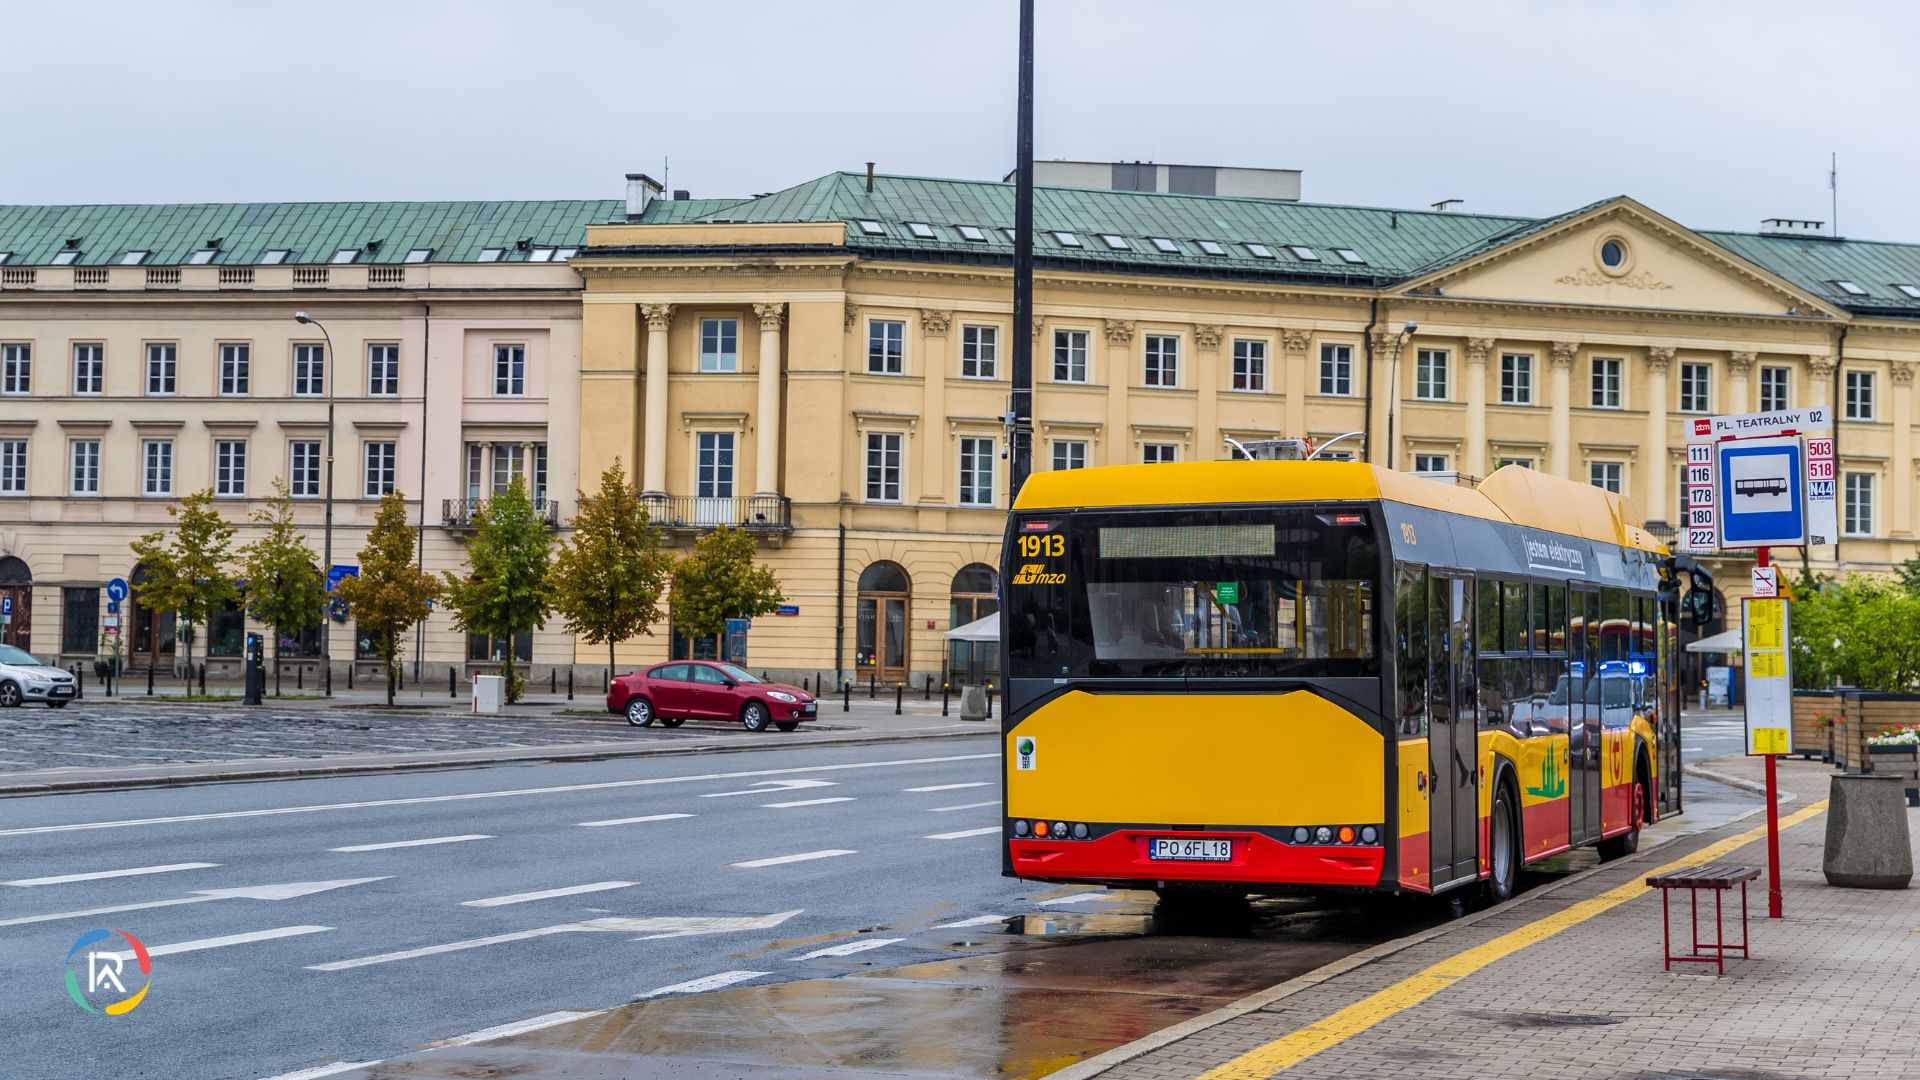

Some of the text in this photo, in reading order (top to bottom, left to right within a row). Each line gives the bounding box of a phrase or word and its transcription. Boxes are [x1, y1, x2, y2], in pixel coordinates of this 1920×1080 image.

[1695, 422, 1711, 431] ztm
[1716, 411, 1823, 430] PL. TEATRALNY 02
[1690, 448, 1709, 461] 111
[1809, 442, 1831, 456] 503
[1690, 468, 1710, 481] 116
[1810, 463, 1832, 476] 518
[1691, 489, 1712, 502] 178
[1810, 481, 1834, 496] N44
[1691, 510, 1712, 523] 180
[1400, 521, 1417, 546] 1913
[1691, 531, 1714, 545] 222
[1017, 534, 1065, 557] 1913
[1526, 536, 1585, 570] jestem elektryczny
[1036, 573, 1067, 584] mza
[1158, 841, 1229, 857] PO 6FL18
